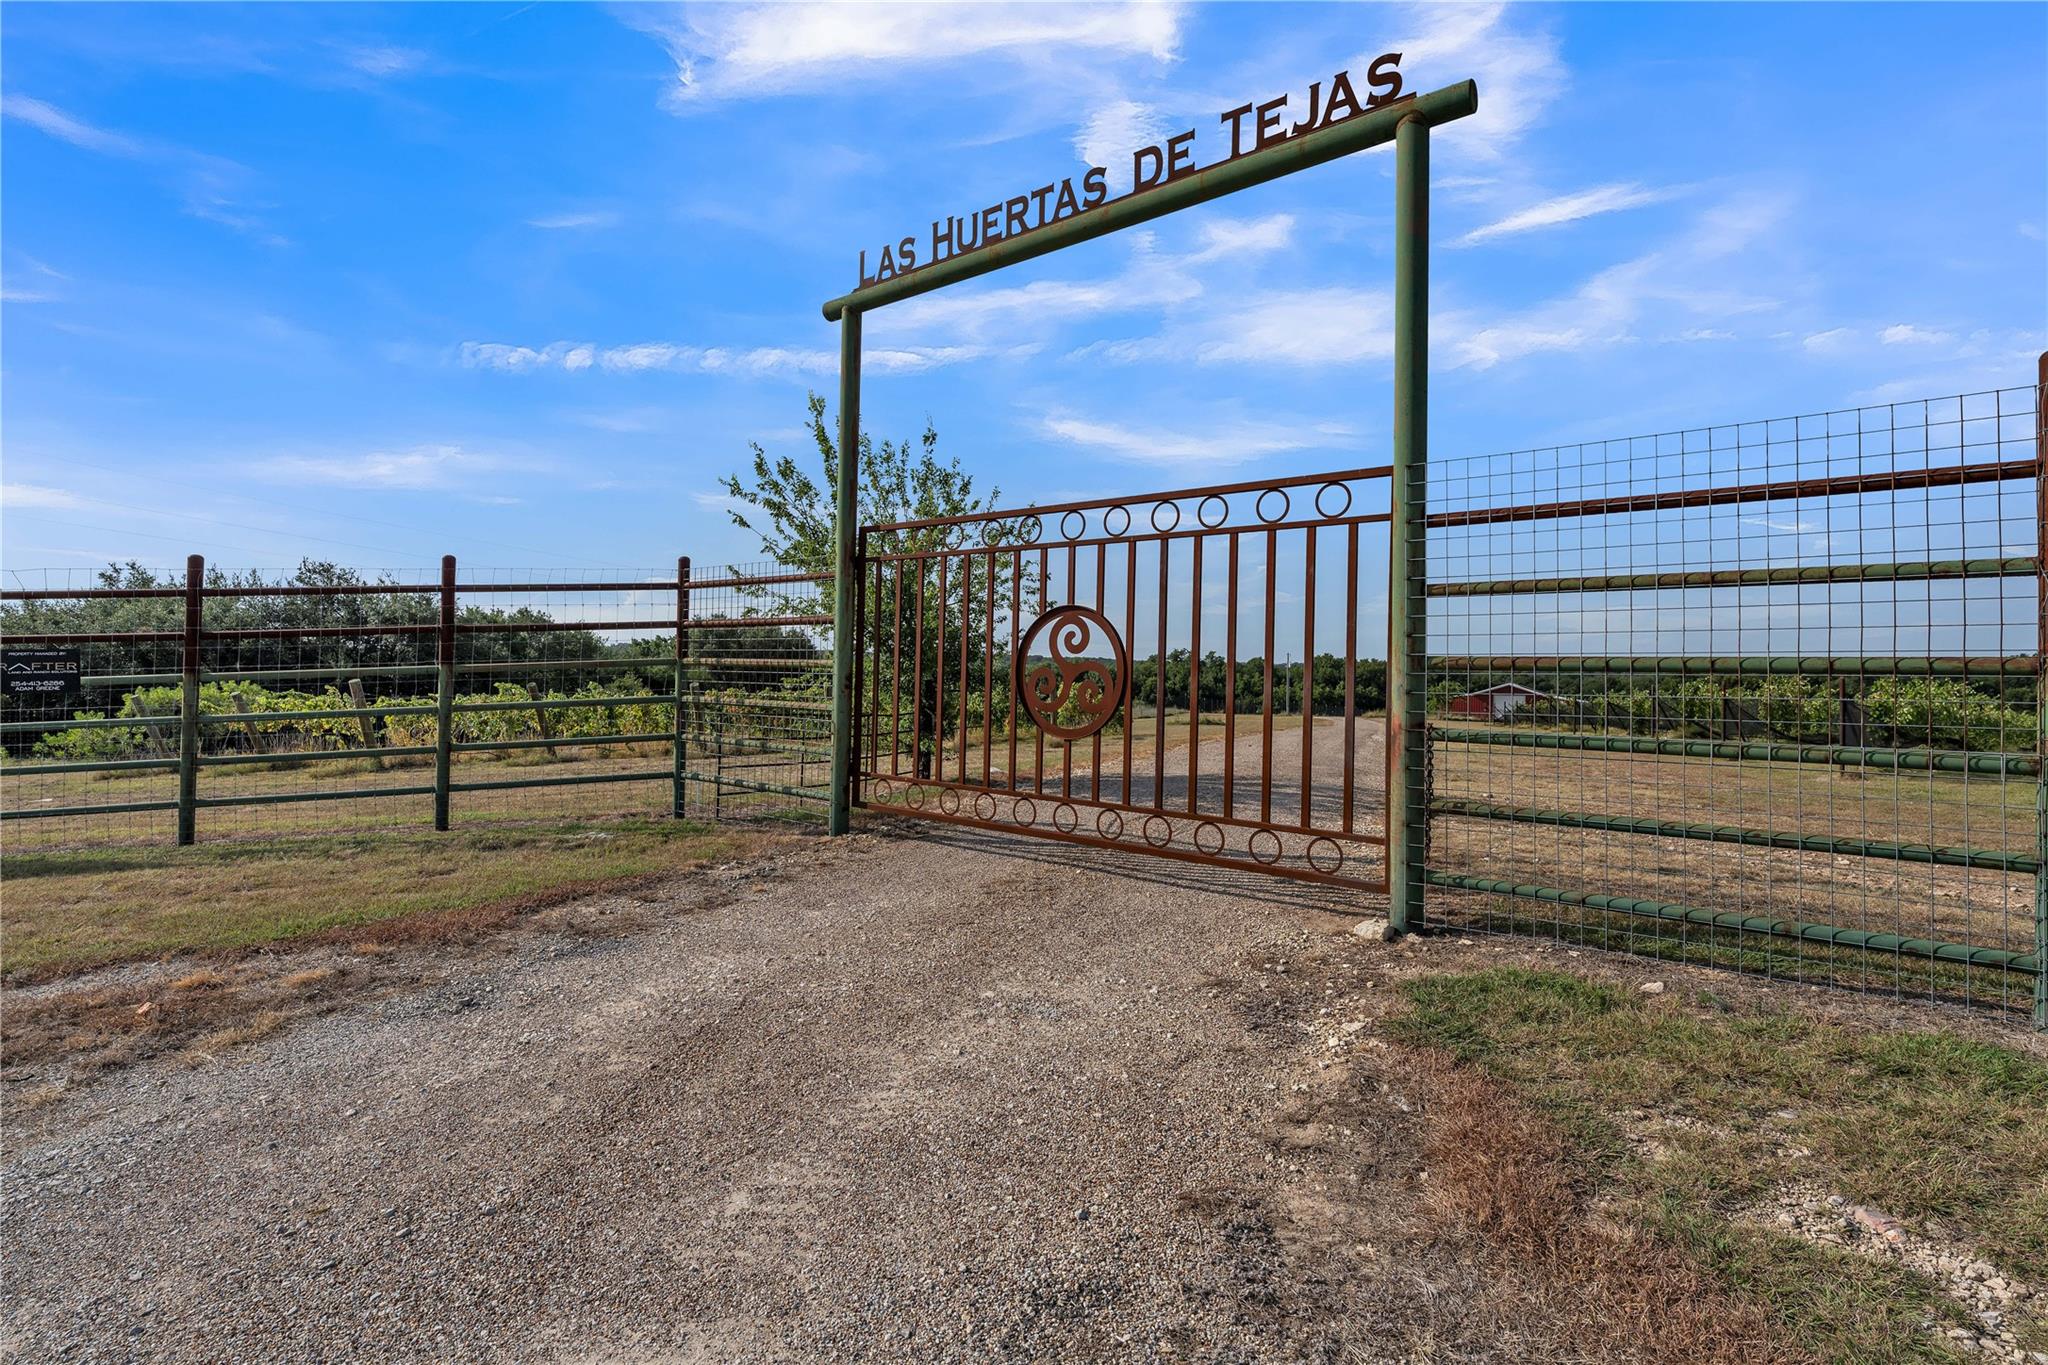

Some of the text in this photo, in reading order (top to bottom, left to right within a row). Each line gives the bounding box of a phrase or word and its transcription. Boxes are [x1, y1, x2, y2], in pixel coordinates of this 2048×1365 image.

[859, 53, 1403, 289] LAS HUERTAS DE TEJAS
